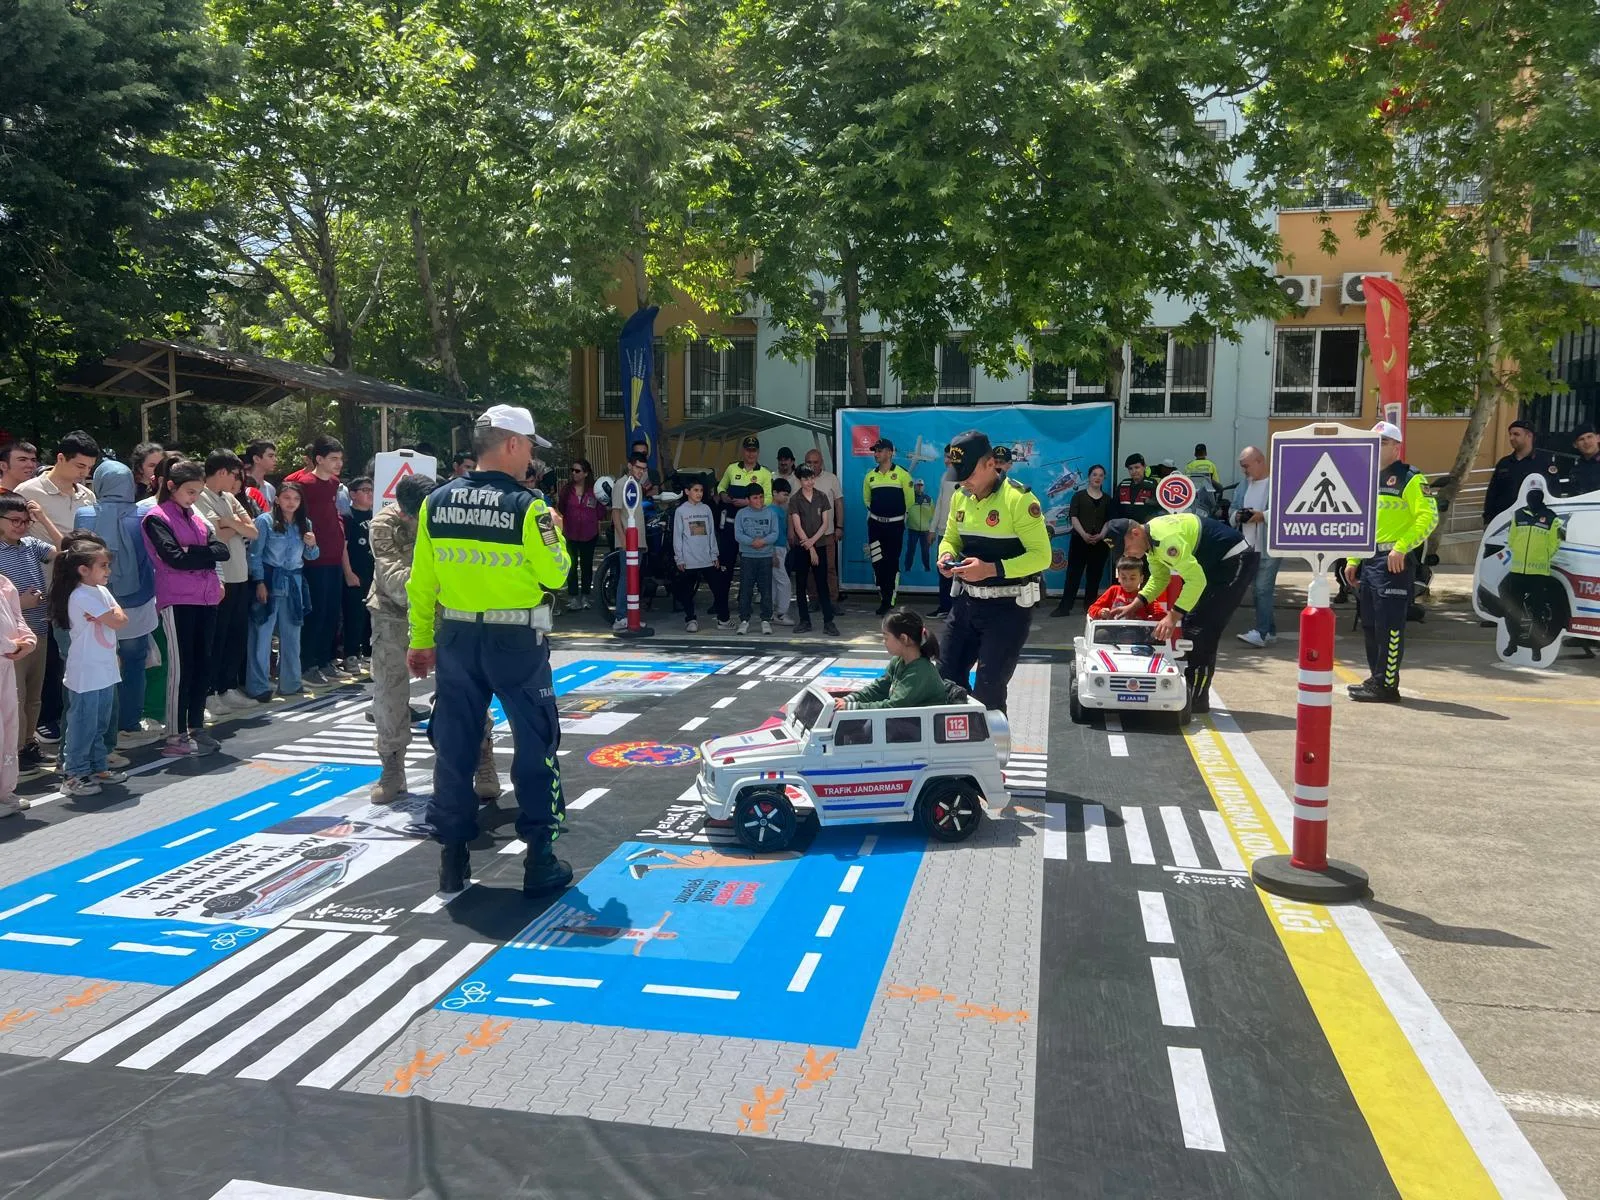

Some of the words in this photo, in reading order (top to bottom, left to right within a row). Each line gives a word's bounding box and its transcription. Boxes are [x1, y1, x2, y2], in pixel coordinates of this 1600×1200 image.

[432, 506, 515, 530] JANDARMASI
[1282, 522, 1318, 536] YAYA
[949, 719, 965, 730] 112
[853, 783, 904, 794] JANDARMASI
[150, 853, 263, 901] JANDARMA
[153, 836, 326, 917] KAHRAMANMARAŞ
